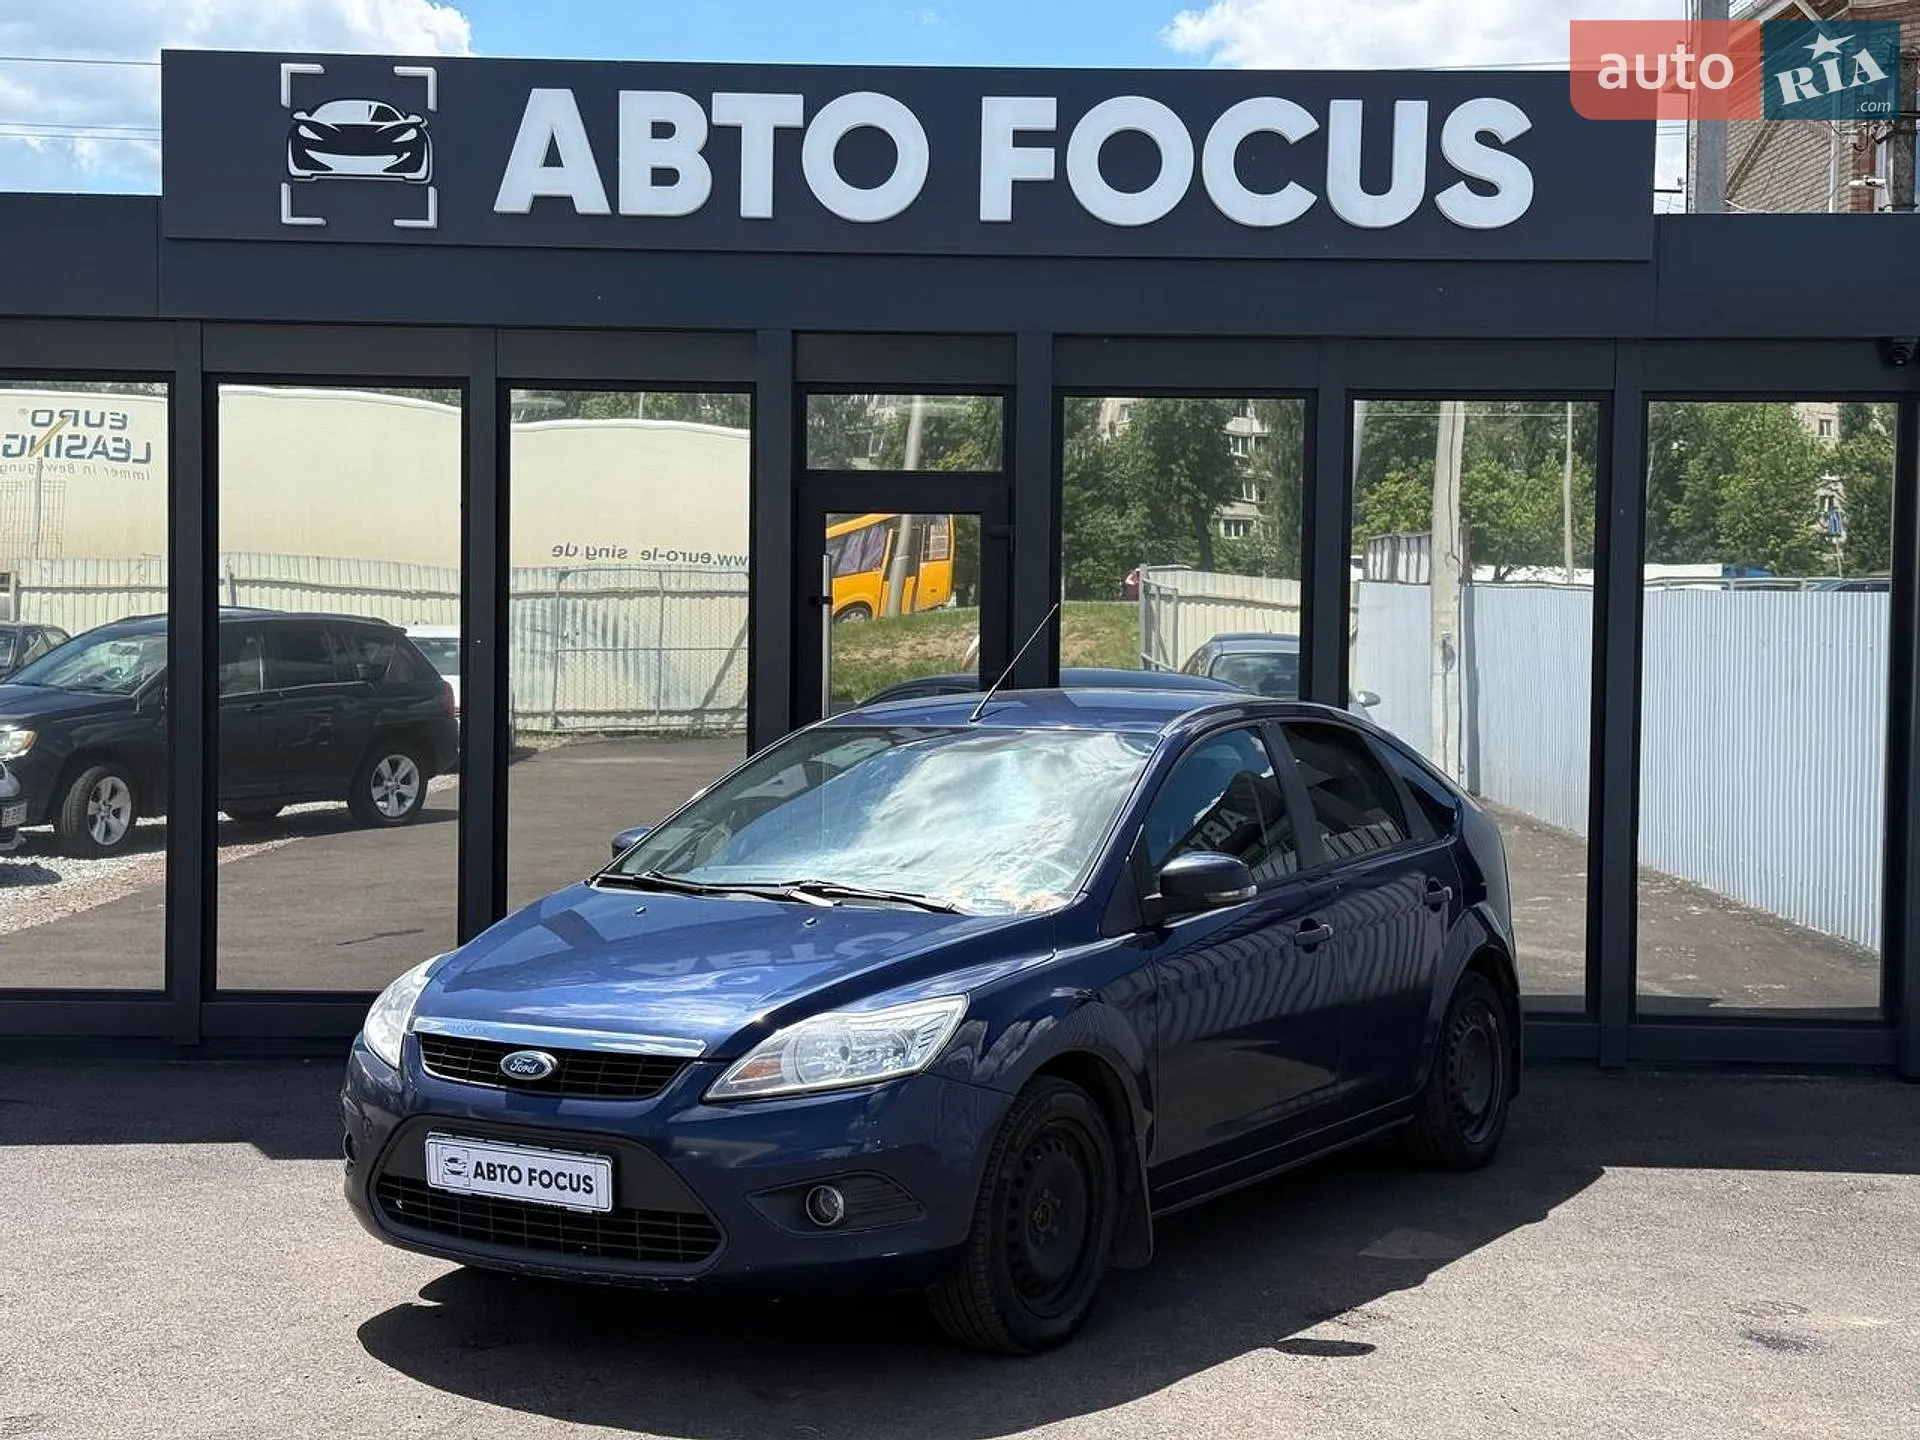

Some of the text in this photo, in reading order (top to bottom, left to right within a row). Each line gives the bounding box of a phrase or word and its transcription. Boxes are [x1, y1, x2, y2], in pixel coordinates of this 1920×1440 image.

[494, 88, 1535, 229] АВТО FOCUS
[510, 1057, 539, 1074] Ford
[473, 1160, 594, 1195] АВТО FOCUS
